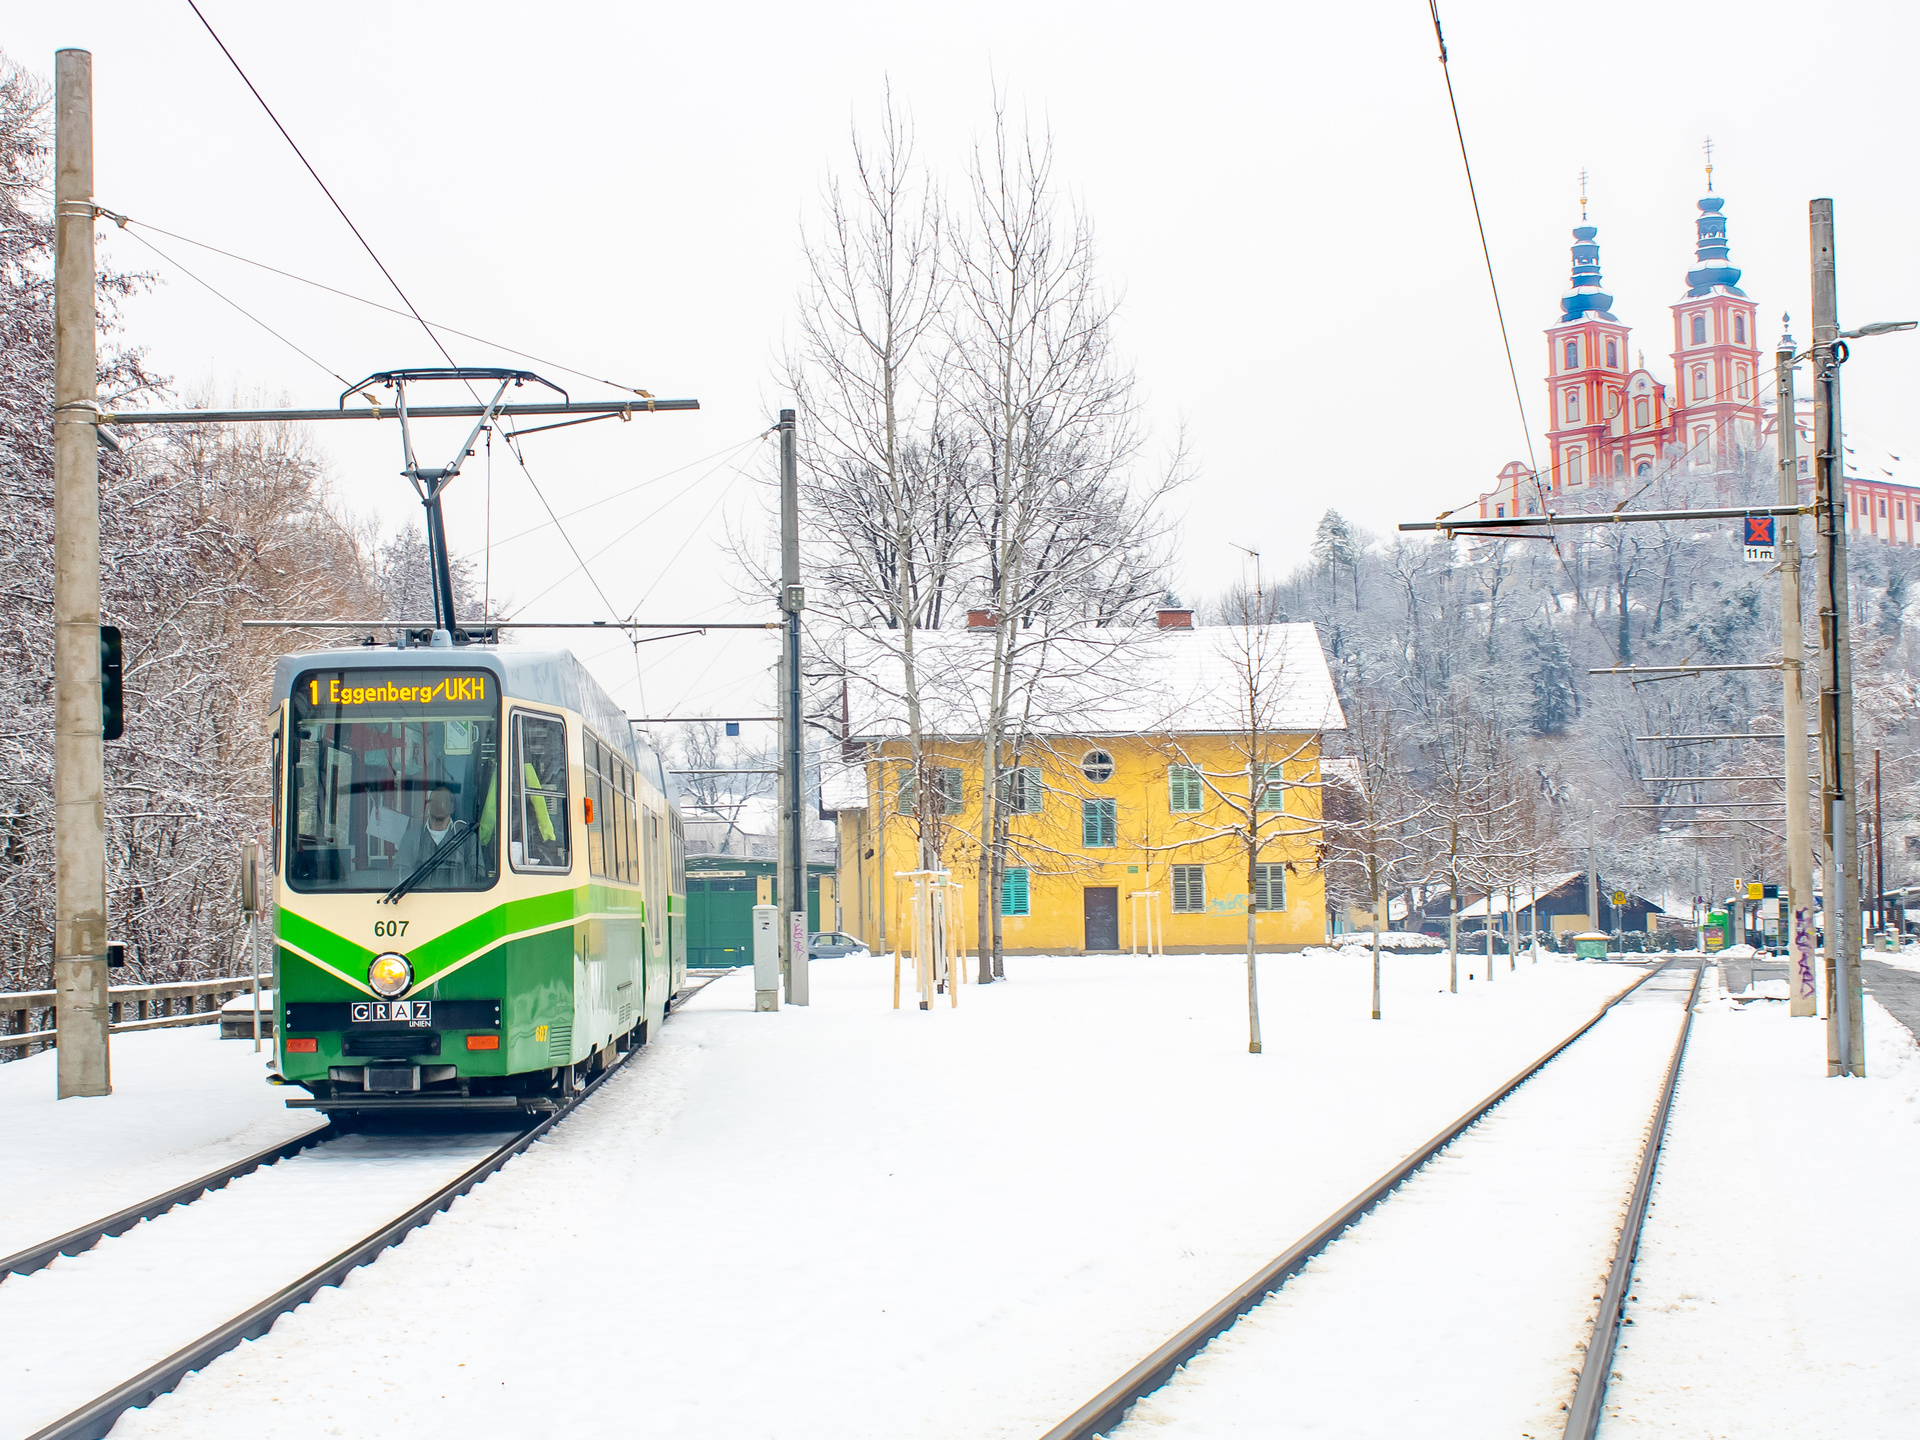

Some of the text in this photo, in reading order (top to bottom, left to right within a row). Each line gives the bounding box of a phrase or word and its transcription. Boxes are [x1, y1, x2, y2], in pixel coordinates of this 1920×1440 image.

[1746, 549, 1757, 558] 11
[310, 677, 484, 705] 1 Eggenberg/UKH
[374, 920, 409, 937] 607
[353, 1003, 429, 1021] GRAZ
[535, 1025, 548, 1042] 607
